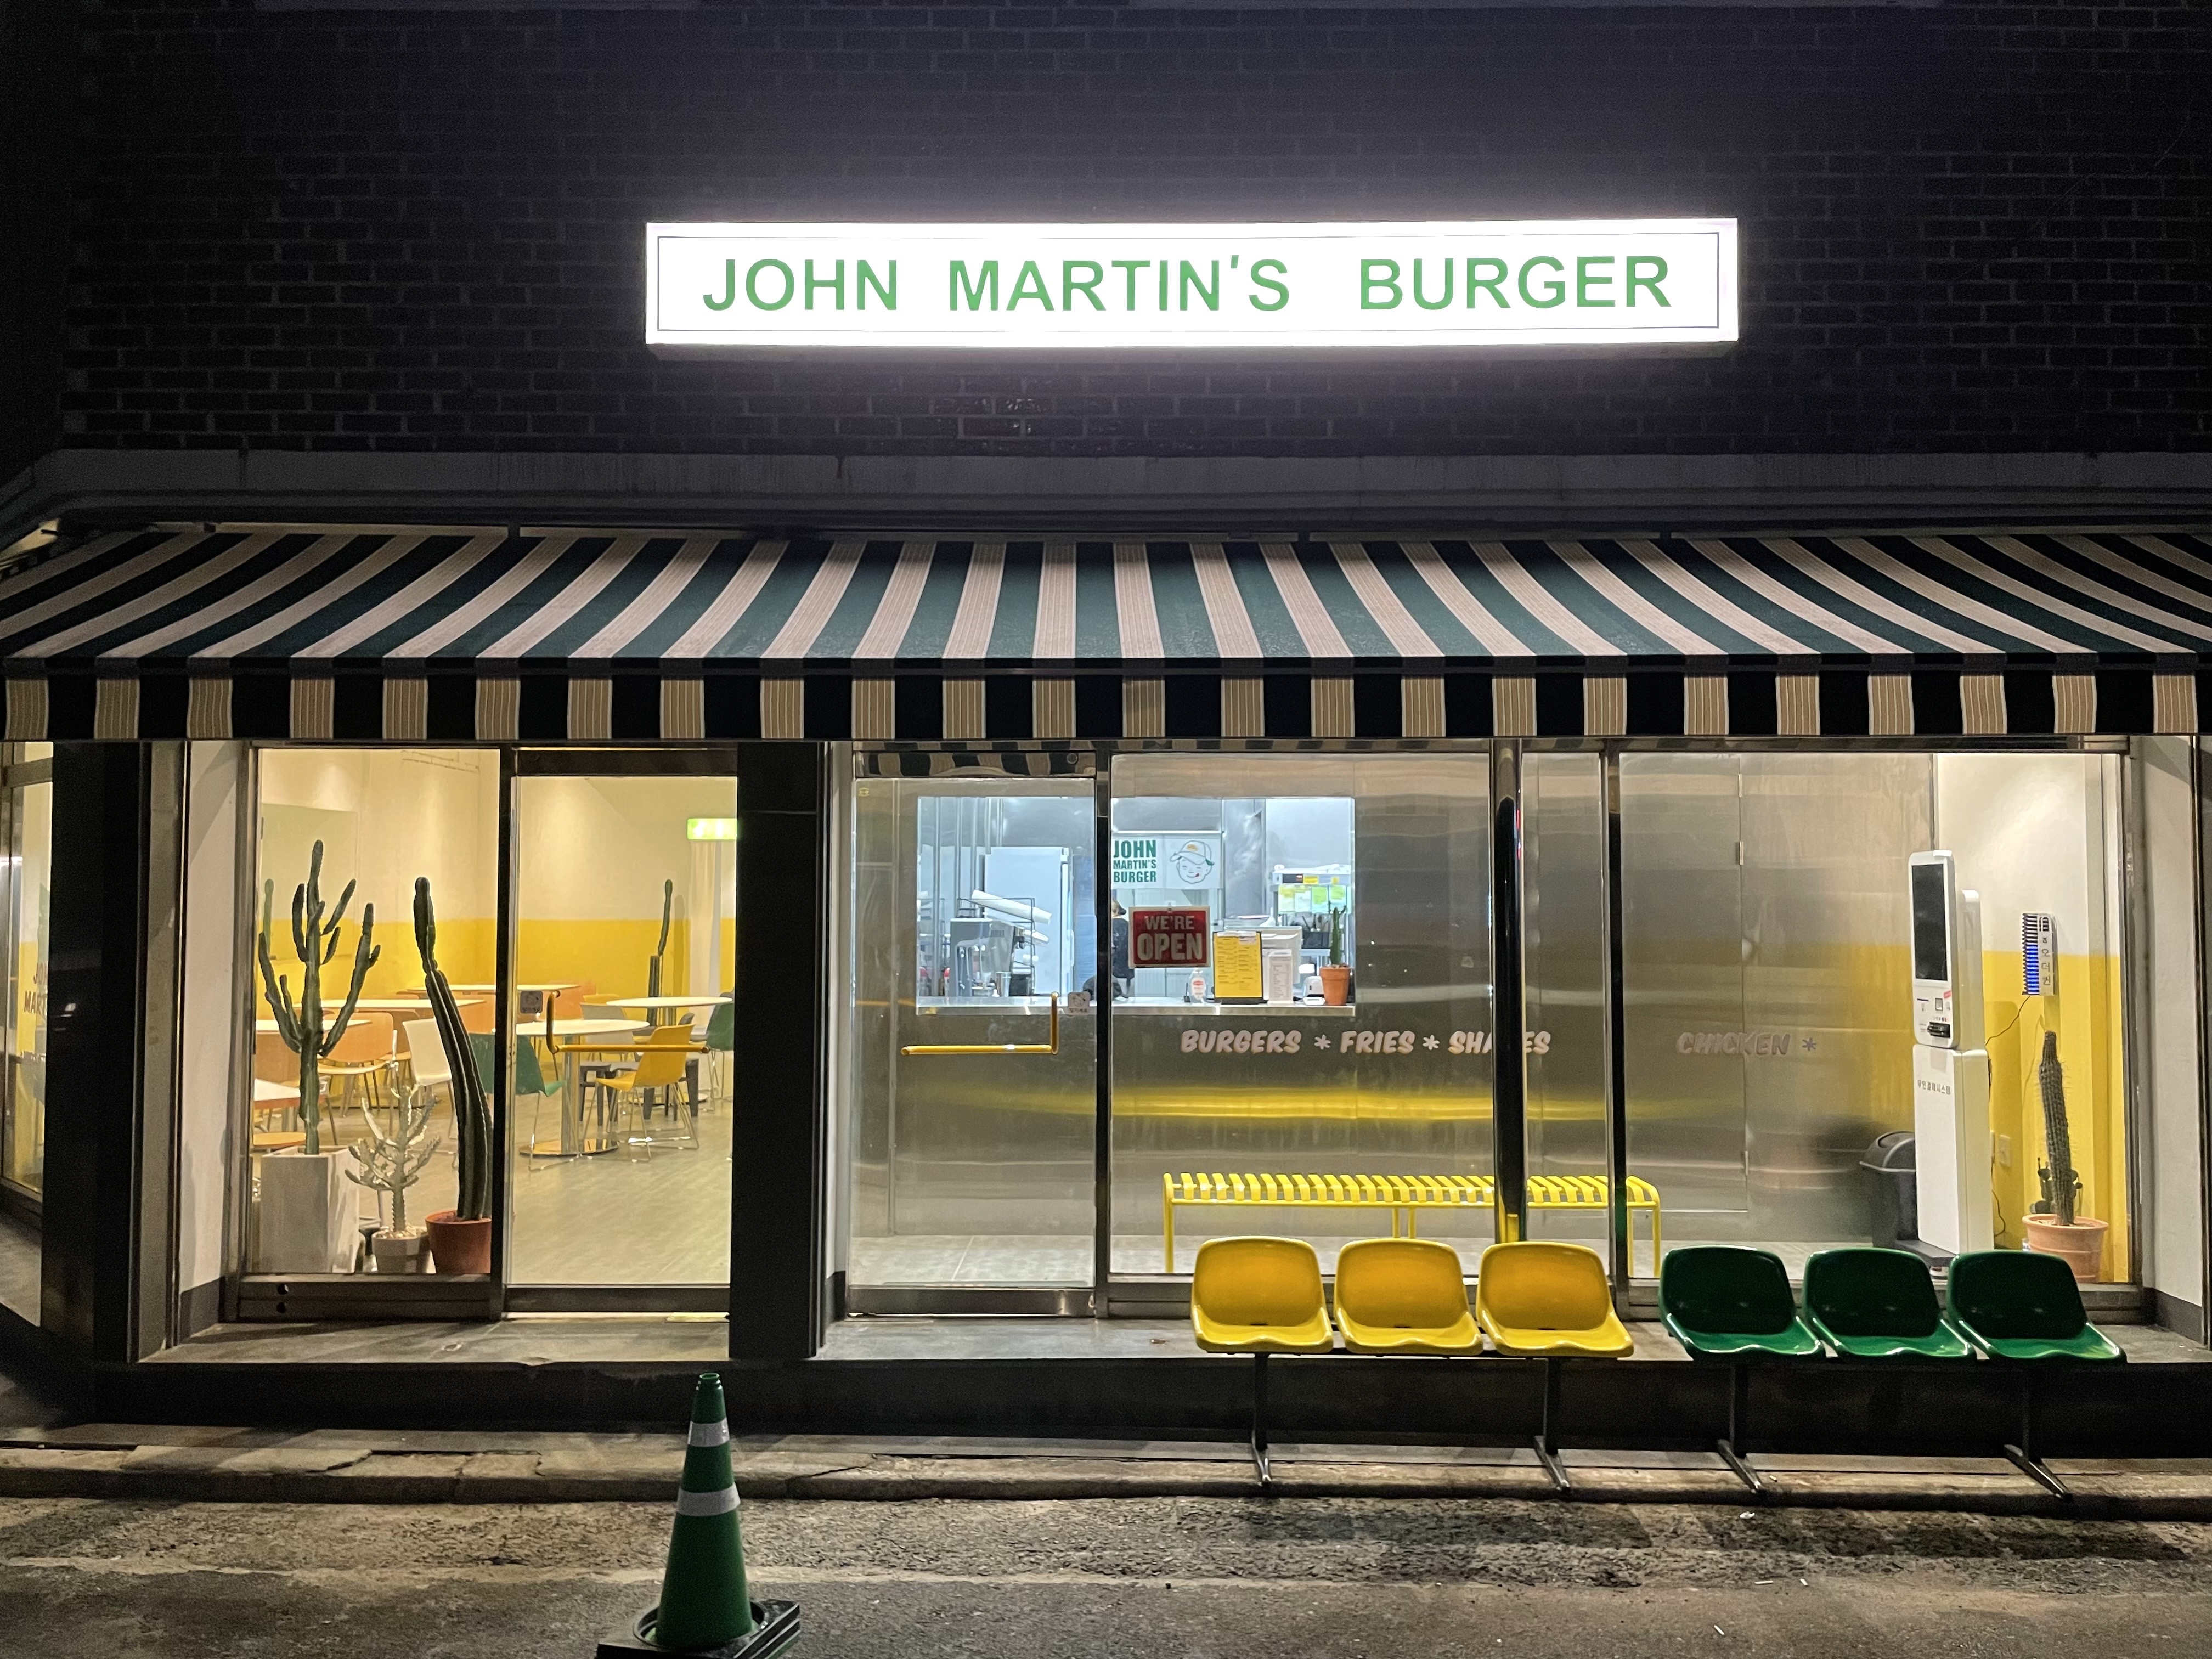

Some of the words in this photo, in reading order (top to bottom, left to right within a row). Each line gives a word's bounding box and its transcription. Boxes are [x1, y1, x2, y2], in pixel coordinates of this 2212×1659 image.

[703, 259, 898, 311] JOHN
[949, 255, 1290, 311] MARTIN'S
[1359, 256, 1671, 309] BURGER
[1113, 840, 1156, 859] JOHN
[1113, 859, 1156, 870] MARTIN'S
[1113, 871, 1156, 883] BURGER
[1144, 915, 1195, 930] WE'RE
[1137, 933, 1203, 961] OPEN
[24, 991, 48, 1014] MART
[1181, 1030, 1301, 1054] BURGERS
[1340, 1030, 1415, 1054] FRIES
[1677, 1032, 1791, 1055] CHICKEN
